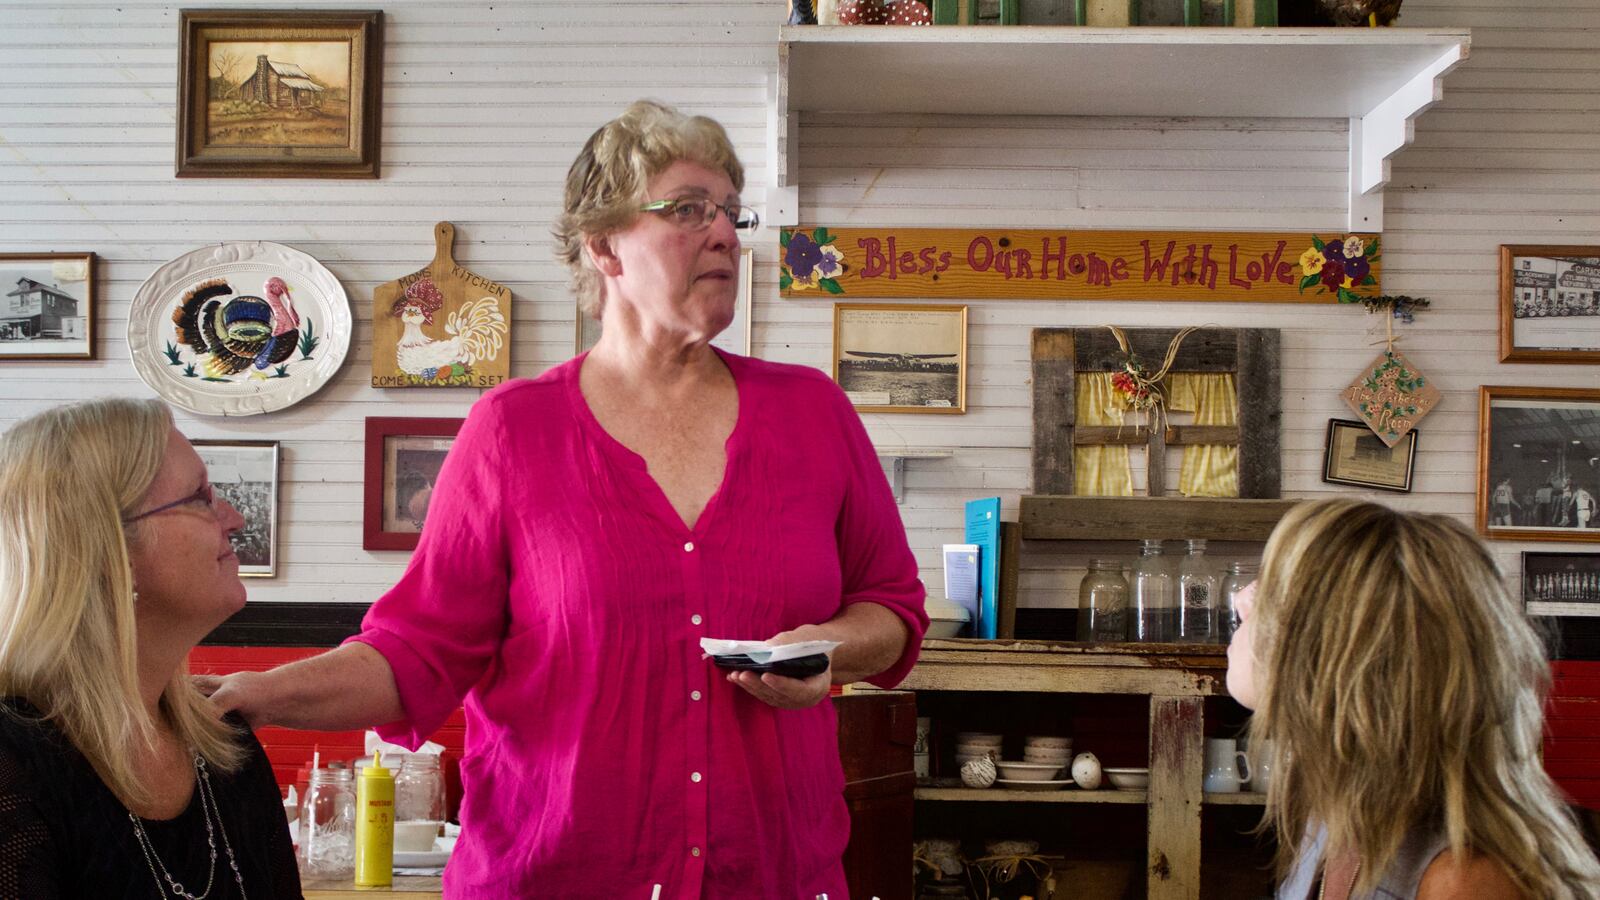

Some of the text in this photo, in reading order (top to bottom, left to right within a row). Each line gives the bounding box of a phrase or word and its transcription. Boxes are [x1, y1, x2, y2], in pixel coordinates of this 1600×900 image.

[858, 236, 952, 279] Bless
[1040, 236, 1130, 286] Home
[1140, 240, 1218, 289] With
[398, 265, 505, 297] MOMS KITCHEN
[371, 375, 504, 386] COME SET
[1350, 386, 1372, 402] The
[1379, 409, 1412, 430] Room
